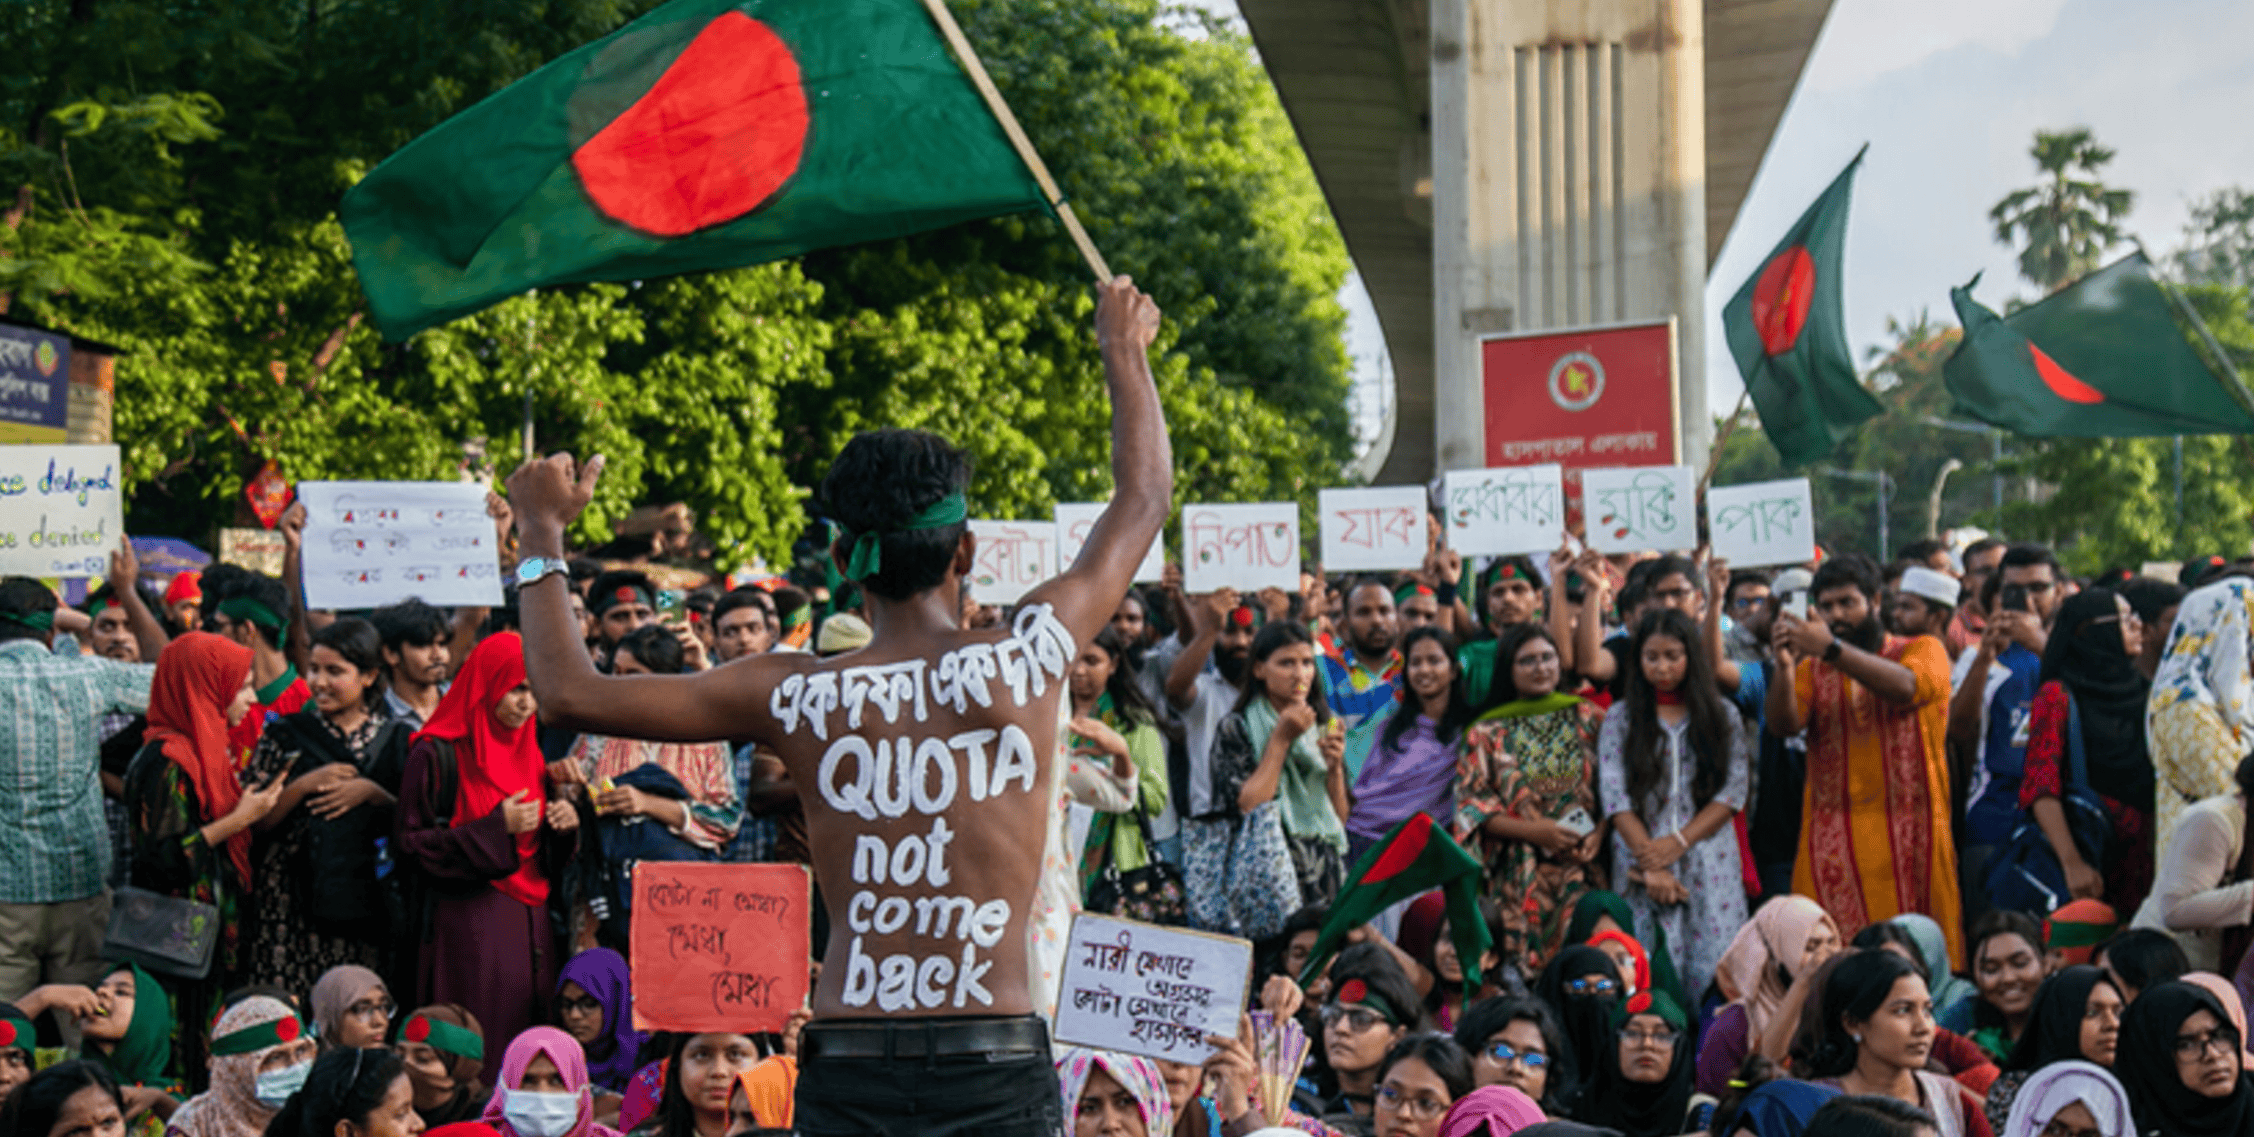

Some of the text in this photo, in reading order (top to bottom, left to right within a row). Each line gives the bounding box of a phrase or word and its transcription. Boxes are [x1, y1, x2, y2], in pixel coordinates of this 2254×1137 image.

[1336, 506, 1416, 549] যাক
[1596, 470, 1677, 541] মুক্তি
[1717, 496, 1802, 543] পাক
[29, 514, 105, 548] denied
[1188, 511, 1294, 571] নিপাত
[818, 724, 1037, 820] QUOTA
[852, 816, 955, 887] not
[648, 877, 696, 917] কোটা
[701, 887, 722, 911] না
[848, 890, 1011, 947] come
[842, 935, 993, 1011] back
[1083, 930, 1132, 974] নারী
[709, 970, 782, 1016] মেধা
[1074, 983, 1191, 1023] কোটা সেখানে
